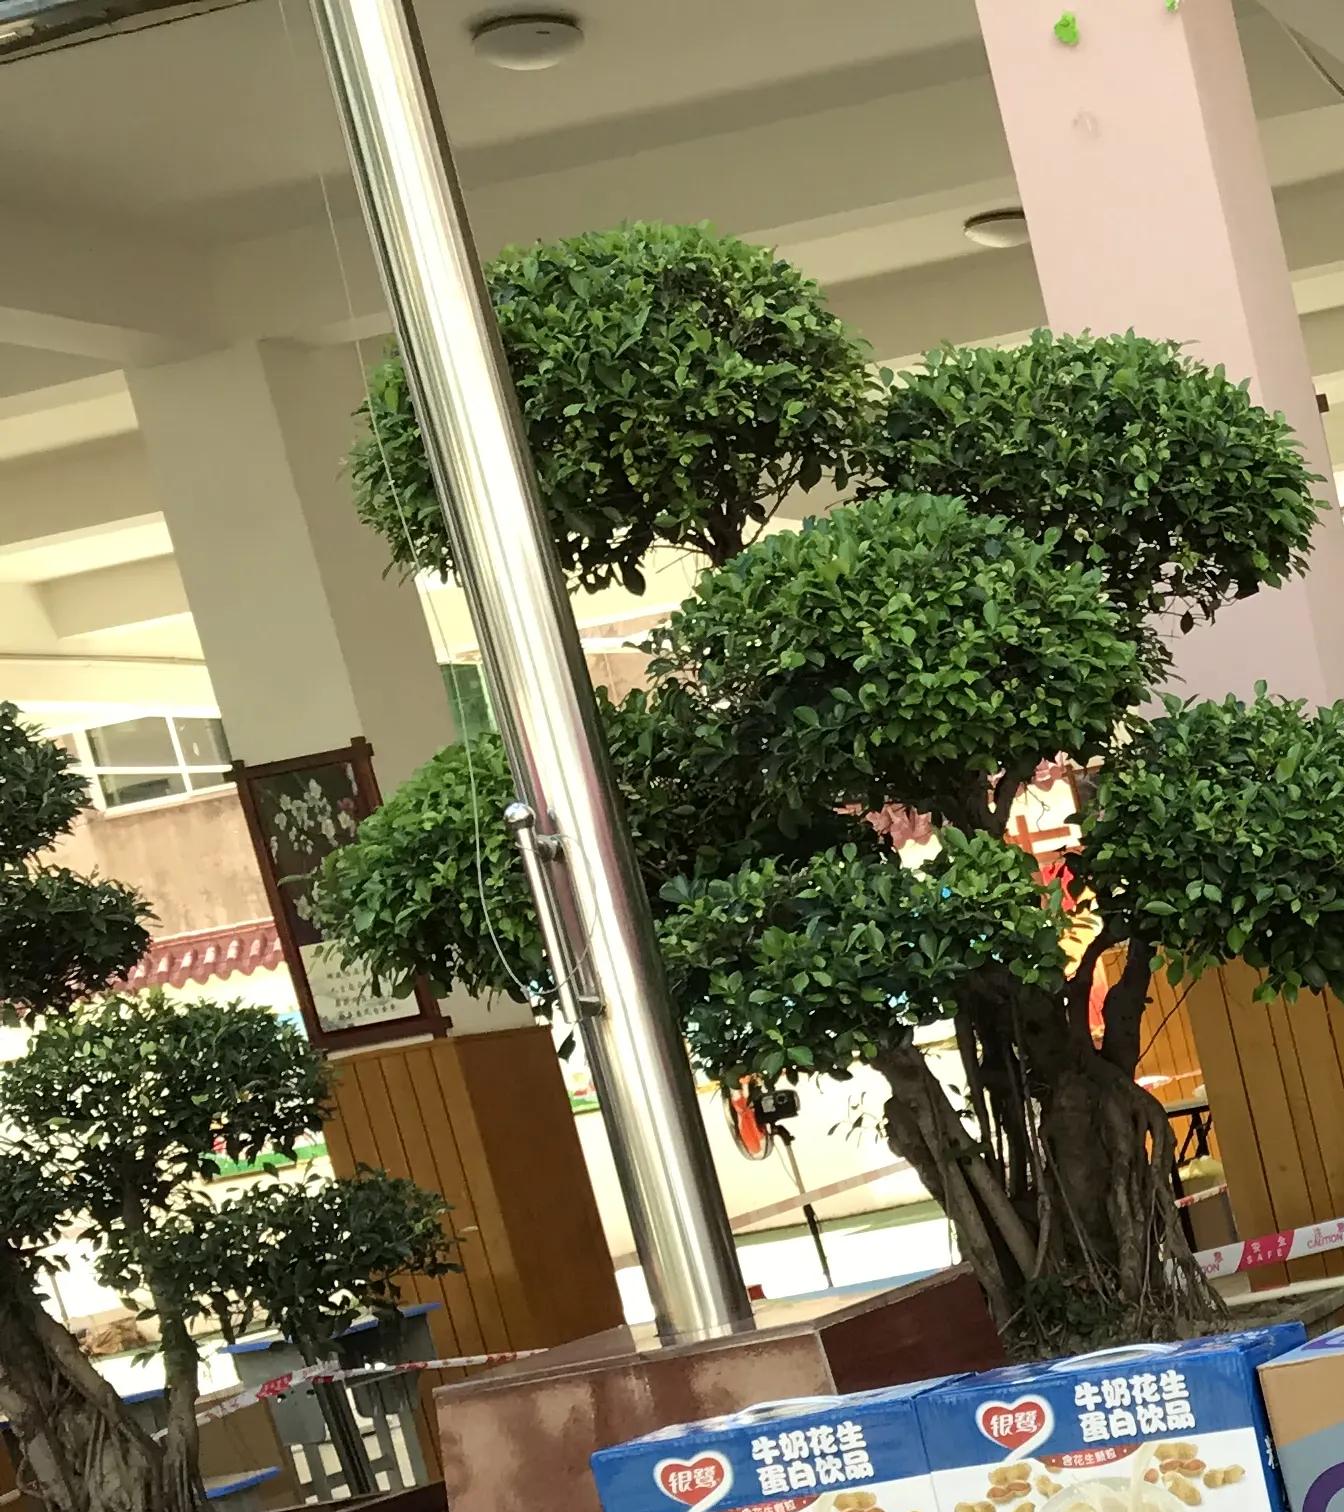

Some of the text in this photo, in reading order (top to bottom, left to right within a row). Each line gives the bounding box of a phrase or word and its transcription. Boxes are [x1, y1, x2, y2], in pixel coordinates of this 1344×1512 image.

[1246, 1248, 1284, 1265] SAFE
[1074, 1370, 1189, 1411] 牛奶花生
[1078, 1400, 1195, 1442] 蛋白饮品
[752, 1421, 866, 1464] 牛奶花生
[1062, 1448, 1117, 1466] 含花生颗粒
[756, 1450, 873, 1495] 蛋白饮品
